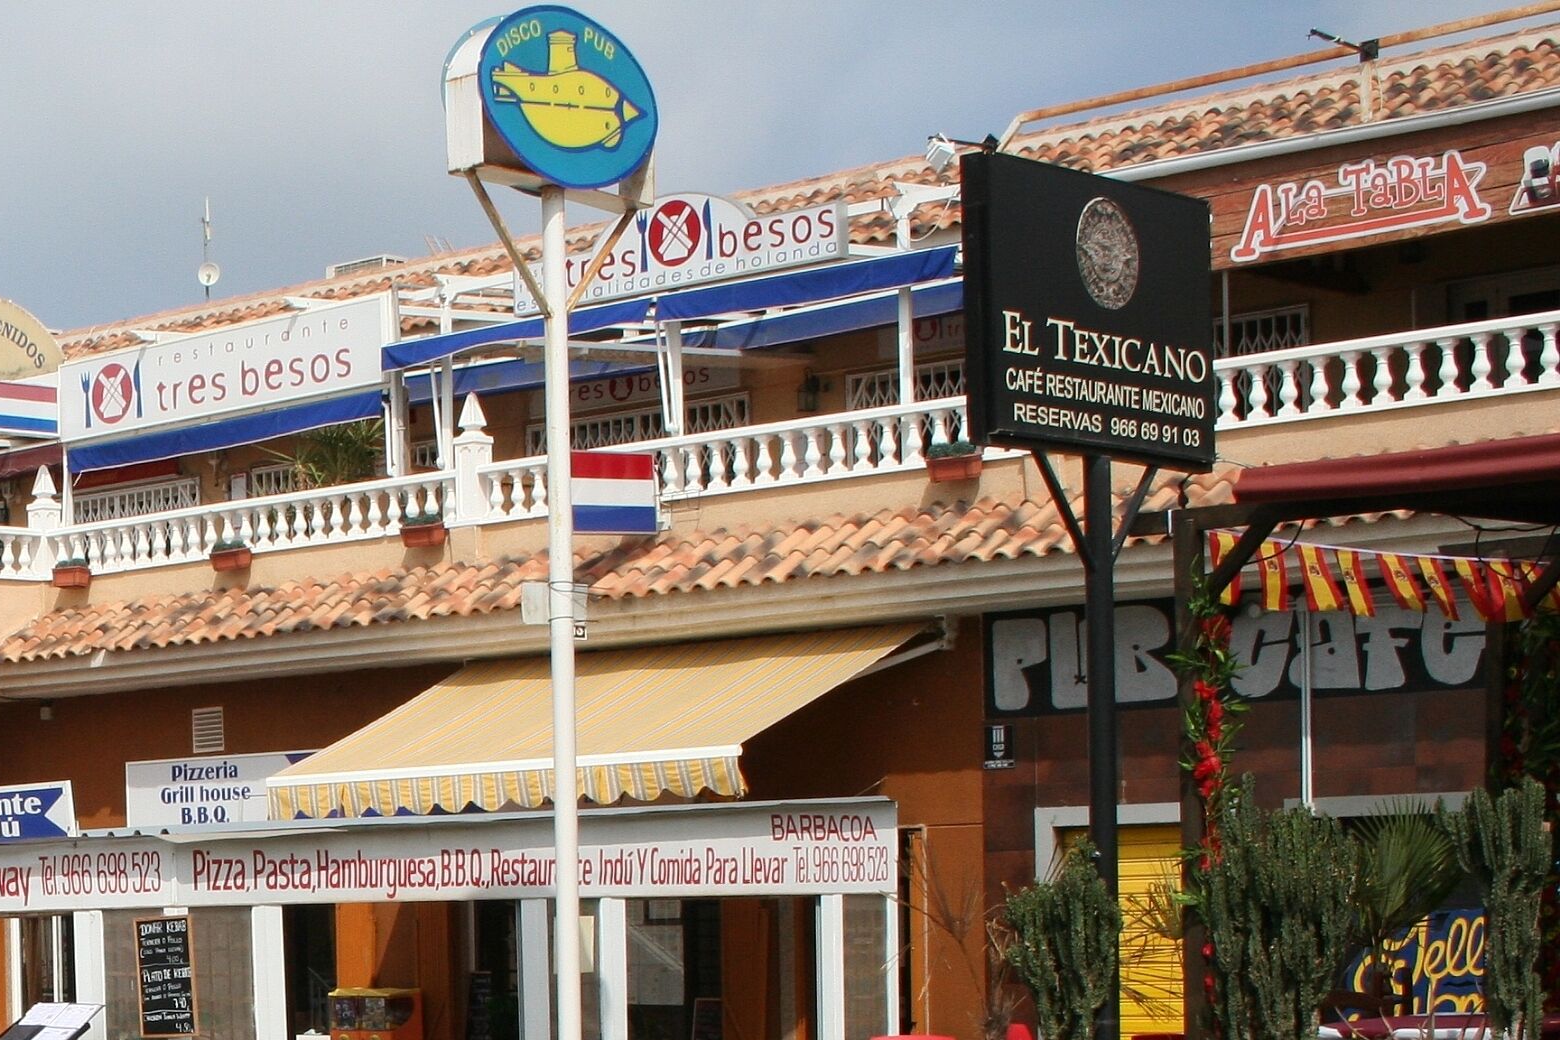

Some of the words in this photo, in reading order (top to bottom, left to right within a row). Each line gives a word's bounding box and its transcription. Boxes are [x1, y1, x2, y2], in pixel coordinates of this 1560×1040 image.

[495, 20, 542, 57] DISCO
[583, 27, 615, 60] PUB
[718, 209, 834, 258] besos
[736, 241, 837, 270] holanda
[158, 317, 350, 367] restaurante
[1002, 310, 1039, 356] EL
[1046, 317, 1207, 384] TEXICANO
[156, 373, 227, 411] tres
[240, 348, 352, 396] besos
[1005, 366, 1044, 395] CAFÉ
[1046, 373, 1140, 410] RESTAURANTE
[1142, 390, 1205, 421] MEXICANO
[1013, 402, 1102, 433] RESERVAS
[1110, 417, 1138, 439] 966
[1141, 421, 1159, 442] 69
[1162, 424, 1179, 445] 91
[1183, 428, 1200, 447] 03
[171, 760, 238, 782] Pizzeria
[161, 785, 194, 804] Grill
[200, 783, 251, 802] house
[181, 805, 230, 825] B.B.Q.
[771, 814, 877, 843] BARBACOA
[96, 852, 130, 895] 698
[132, 851, 161, 893] 523
[598, 848, 633, 886] Indú
[637, 848, 648, 886] Y
[650, 847, 702, 885] Comida
[706, 847, 738, 885] Para
[742, 846, 789, 885] Llevar
[842, 846, 865, 883] 698
[867, 846, 889, 882] 523
